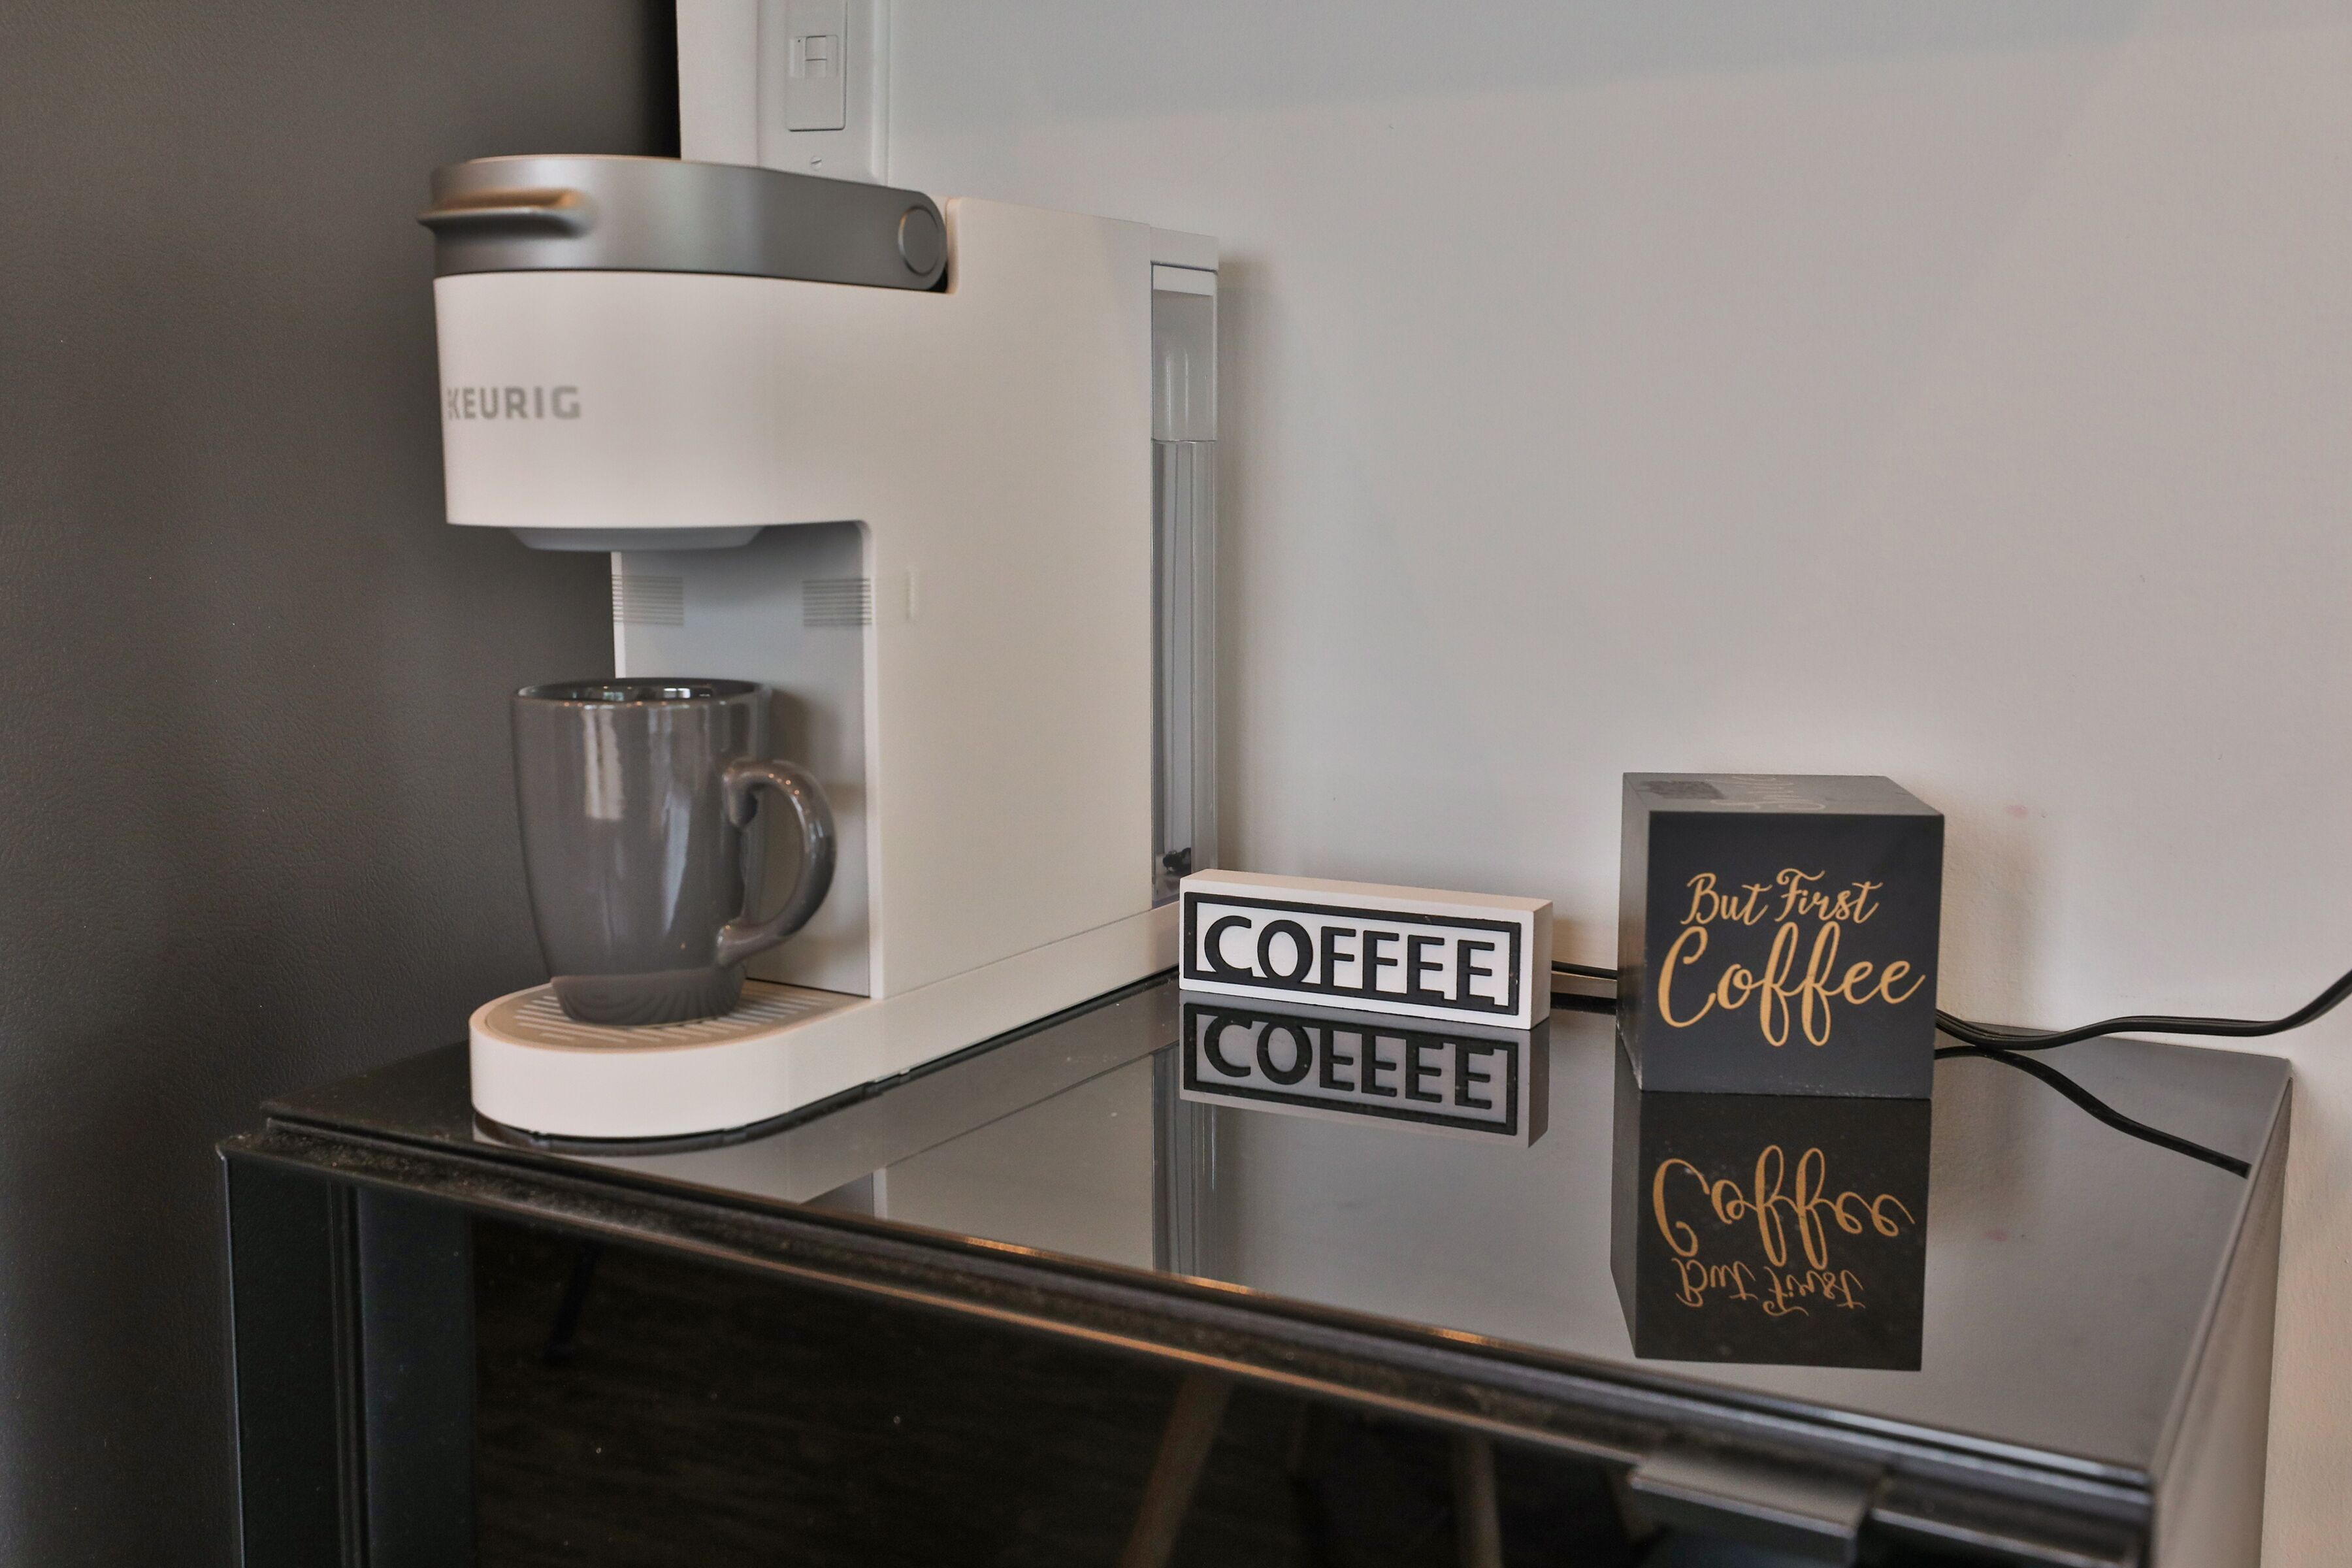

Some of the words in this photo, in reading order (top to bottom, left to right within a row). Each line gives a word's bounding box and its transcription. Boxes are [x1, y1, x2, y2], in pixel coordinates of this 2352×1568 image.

[447, 385, 581, 419] KEURIG
[1680, 873, 1772, 926] But
[1774, 868, 1884, 924] First
[1204, 915, 1495, 1004] COFFEE
[1658, 921, 1926, 1047] Coffee
